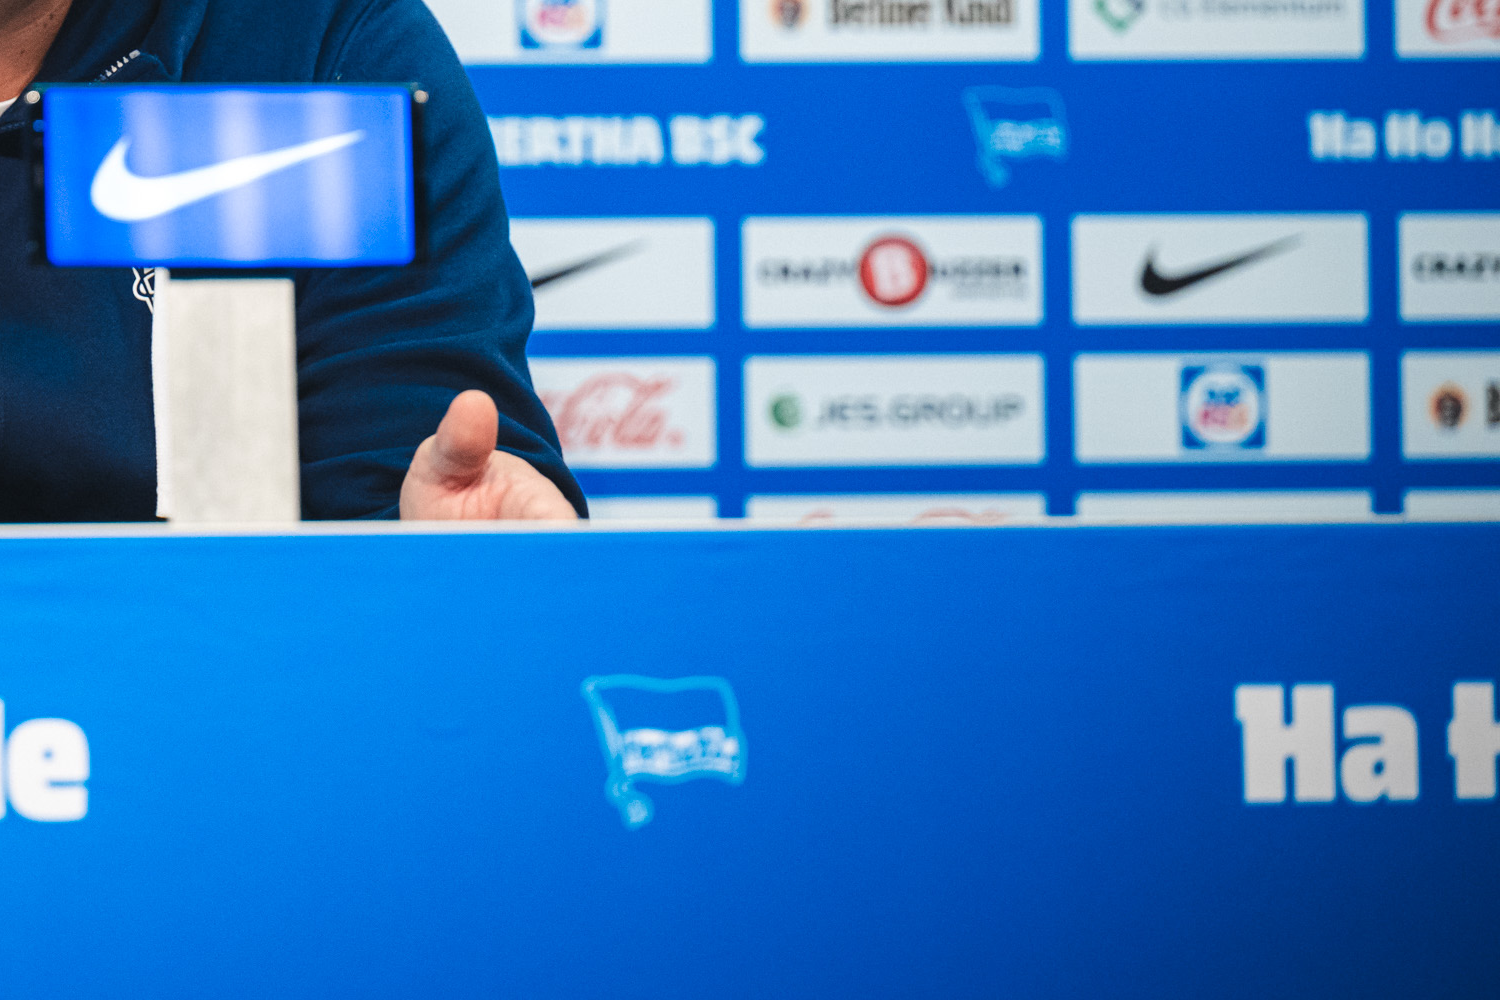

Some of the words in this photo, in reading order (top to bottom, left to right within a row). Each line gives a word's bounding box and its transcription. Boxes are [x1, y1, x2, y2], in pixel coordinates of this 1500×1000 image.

[488, 116, 664, 166] ERTHA
[668, 115, 766, 166] BSC
[1309, 111, 1375, 159] Ha
[1385, 111, 1451, 159] Ho
[1235, 683, 1419, 803] Ha
